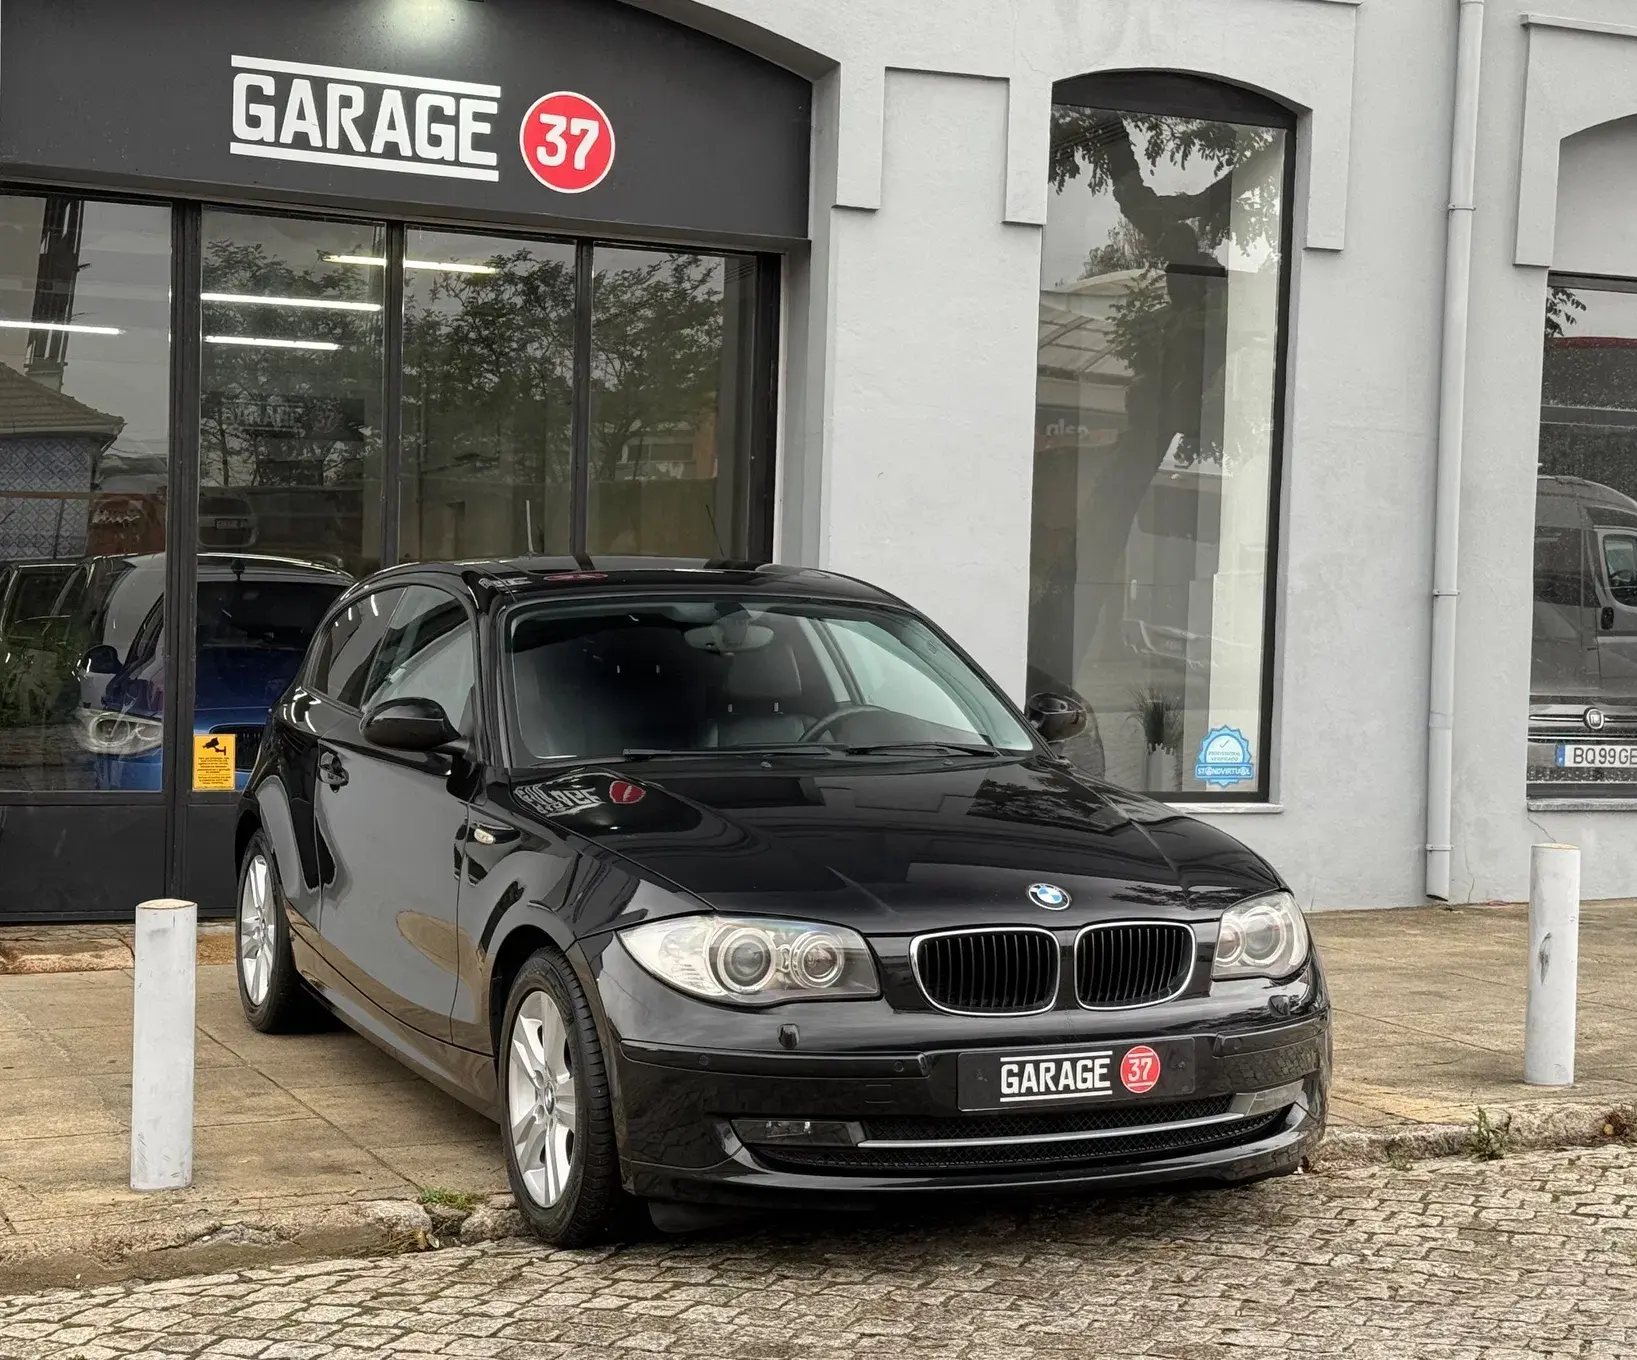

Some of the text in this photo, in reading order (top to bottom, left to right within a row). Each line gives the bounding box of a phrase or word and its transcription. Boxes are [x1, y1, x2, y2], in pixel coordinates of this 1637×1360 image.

[232, 72, 599, 171] GARAGE 37
[1573, 747, 1596, 765] BQ
[1598, 748, 1617, 765] 99
[1000, 1057, 1153, 1095] GARAGE 37
